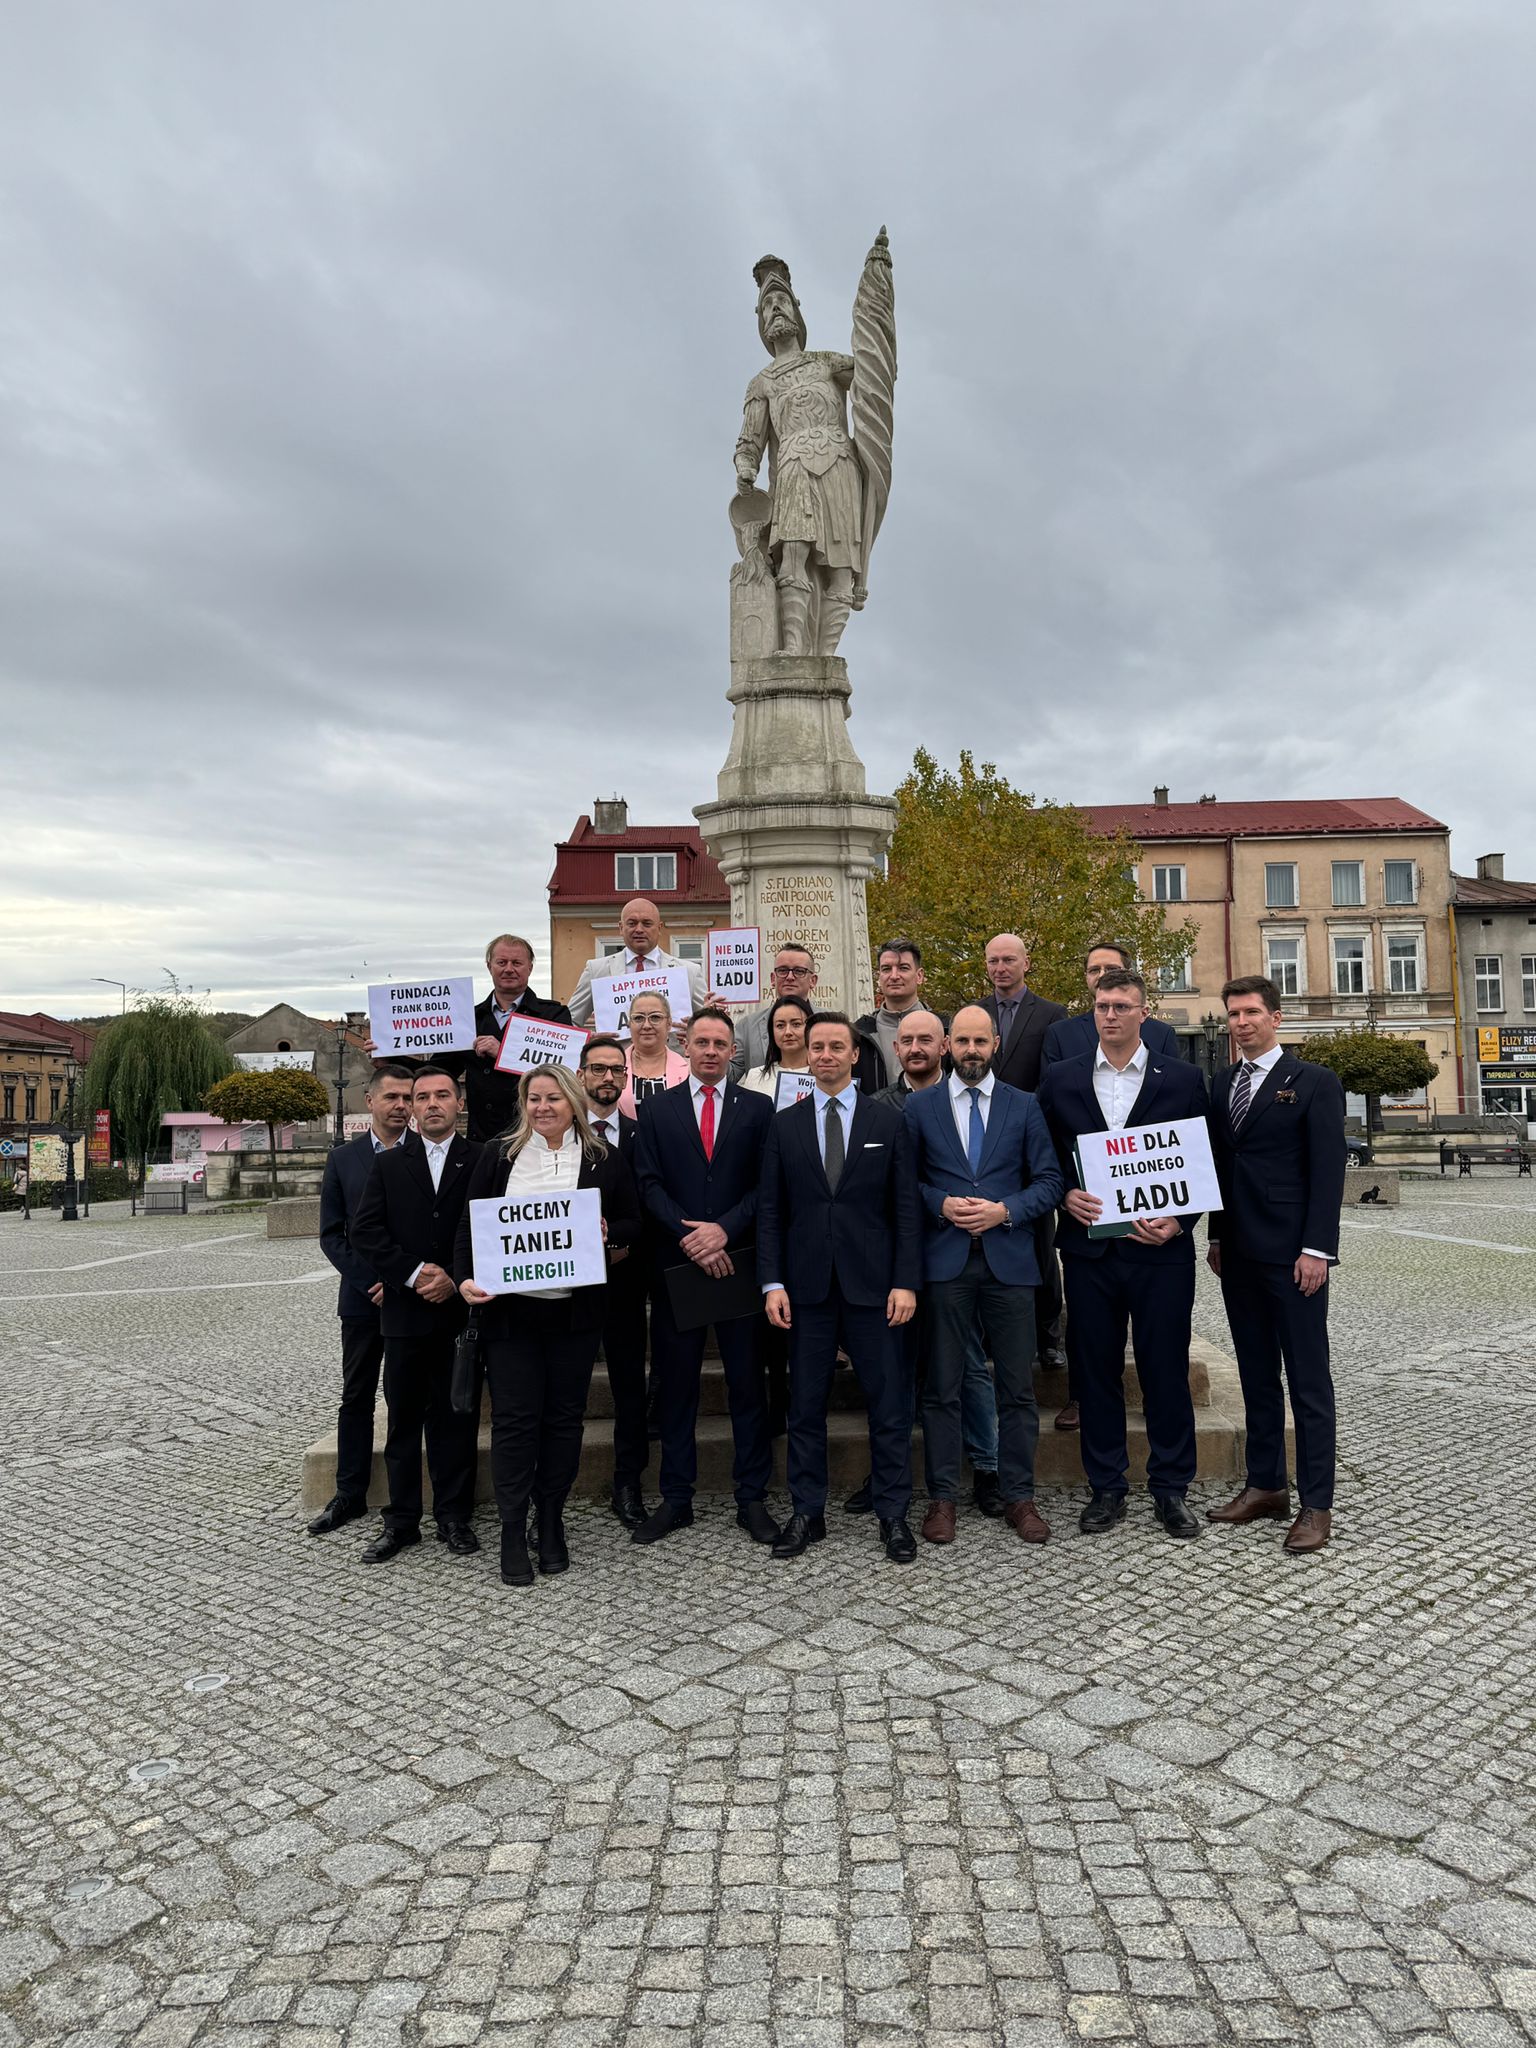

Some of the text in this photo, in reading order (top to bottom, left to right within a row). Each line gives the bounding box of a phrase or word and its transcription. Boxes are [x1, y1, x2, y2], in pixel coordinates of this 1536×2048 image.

[760, 891, 788, 904] REGNI
[772, 904, 830, 917] PATRONO
[715, 944, 754, 955] NIE DLA
[715, 958, 754, 967] ZIELONEGO
[612, 976, 667, 992] ŁAPY PRECZ
[716, 971, 753, 986] ŁADU
[390, 985, 451, 1000] FUNDACJA
[613, 995, 626, 1004] OD
[392, 1002, 451, 1014] FRANK BOLD,
[392, 1015, 452, 1031] WYNOCHA
[394, 1032, 454, 1048] Z POLSKI!
[527, 1026, 569, 1041] ŁAPY PRECZ
[1501, 1036, 1521, 1045] FLIZY
[524, 1035, 567, 1050] OD NASZYCH
[1105, 1129, 1181, 1156] NIE DLA
[1109, 1156, 1184, 1178] ZIELONEGO
[1116, 1180, 1190, 1214] ŁADU
[498, 1200, 571, 1223] CHCEMY
[500, 1229, 573, 1255] TANIEJ
[502, 1260, 575, 1283] ENERGII!
